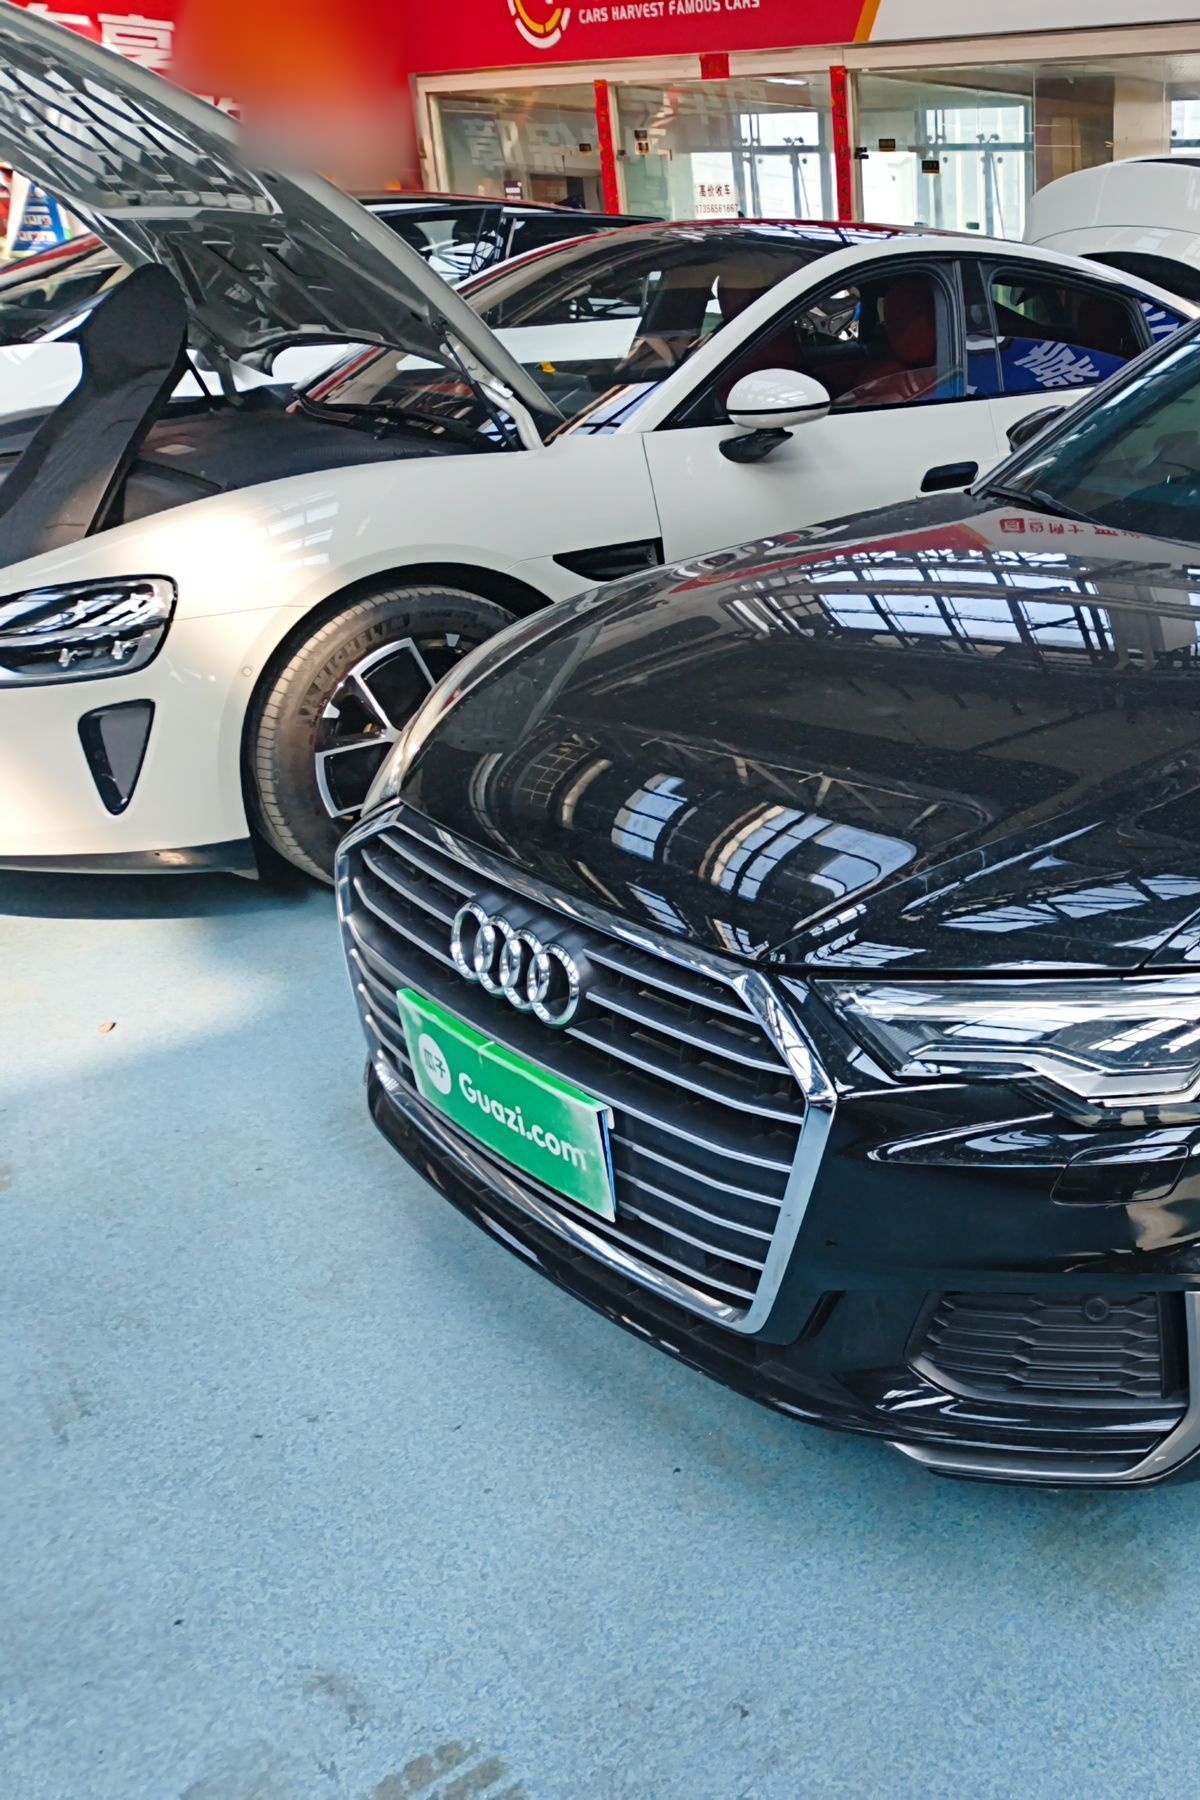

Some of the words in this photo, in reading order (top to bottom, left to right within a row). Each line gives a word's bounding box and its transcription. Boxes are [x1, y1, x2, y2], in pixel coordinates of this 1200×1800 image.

[578, 7, 609, 24] CARS
[611, 2, 665, 21] HARVEST
[668, 0, 721, 15] FAMOUS
[699, 184, 731, 197] 高价收车
[458, 1072, 588, 1172] Guazi.com
